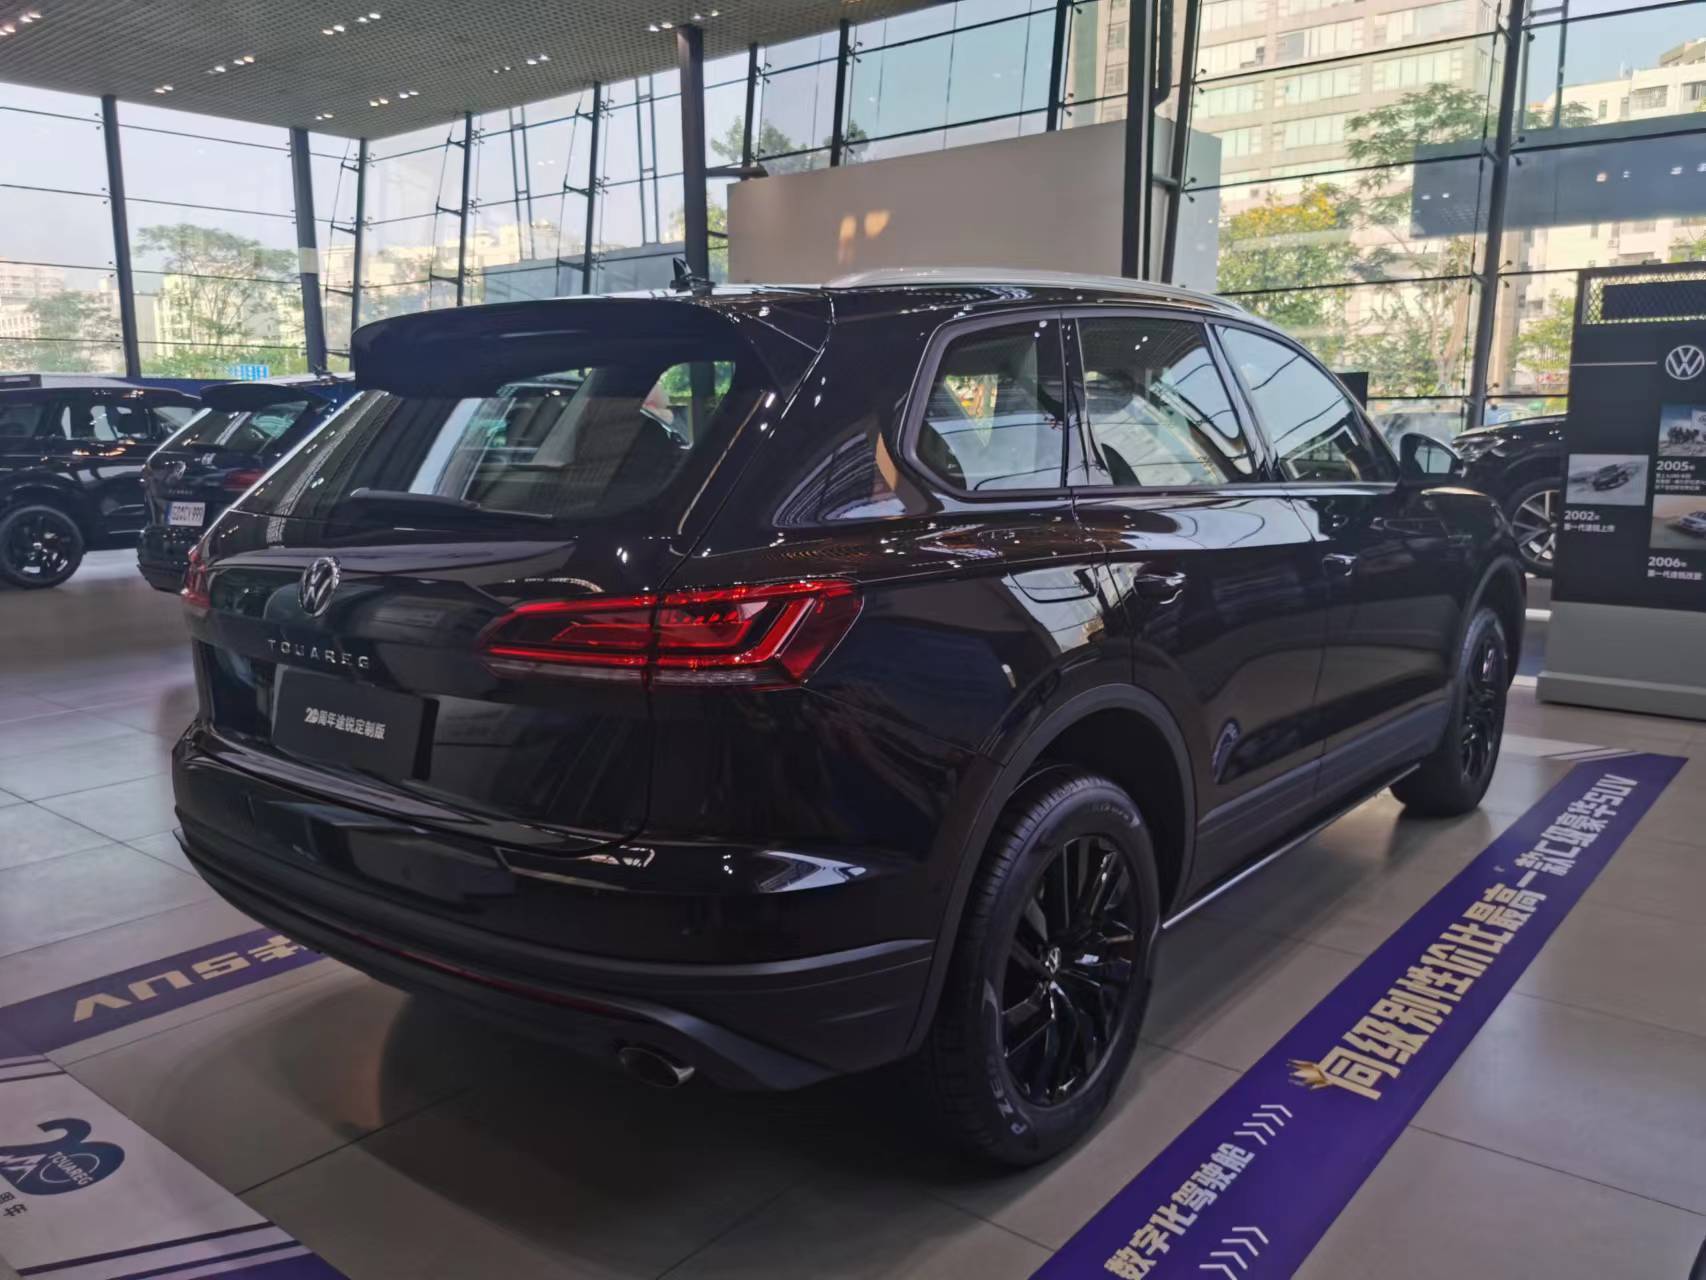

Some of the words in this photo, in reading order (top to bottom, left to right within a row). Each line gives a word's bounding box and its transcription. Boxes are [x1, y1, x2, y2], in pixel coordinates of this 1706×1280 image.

[267, 639, 369, 669] TOUAREG
[47, 1151, 95, 1186] TOUAREG
[1104, 1141, 1256, 1280] 数字化驾驶舱
